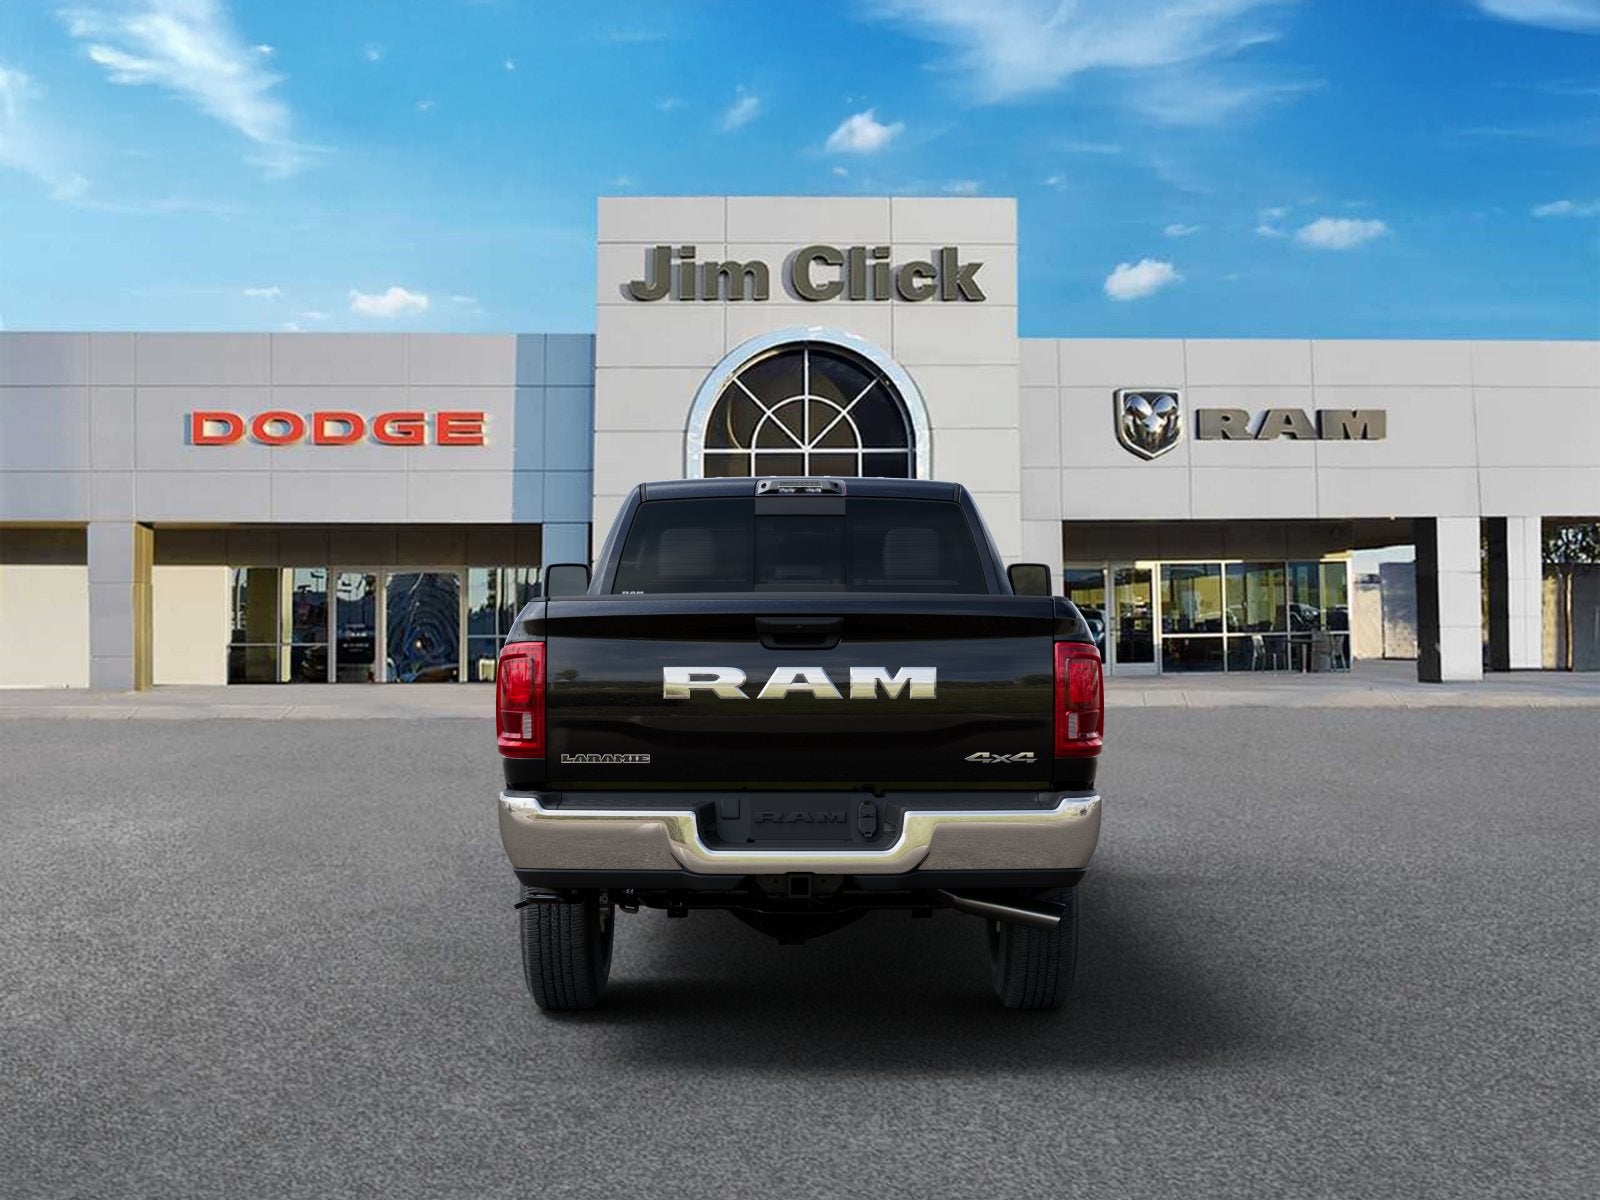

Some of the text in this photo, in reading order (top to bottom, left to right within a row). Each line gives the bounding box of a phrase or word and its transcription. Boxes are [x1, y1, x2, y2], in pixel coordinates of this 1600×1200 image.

[626, 245, 986, 301] Jim Click
[190, 410, 486, 446] DODGE
[1195, 408, 1387, 440] RAM
[663, 666, 937, 700] RAM
[560, 753, 651, 764] LARAMIE
[963, 751, 1038, 764] 4x4
[754, 810, 848, 825] RAM
